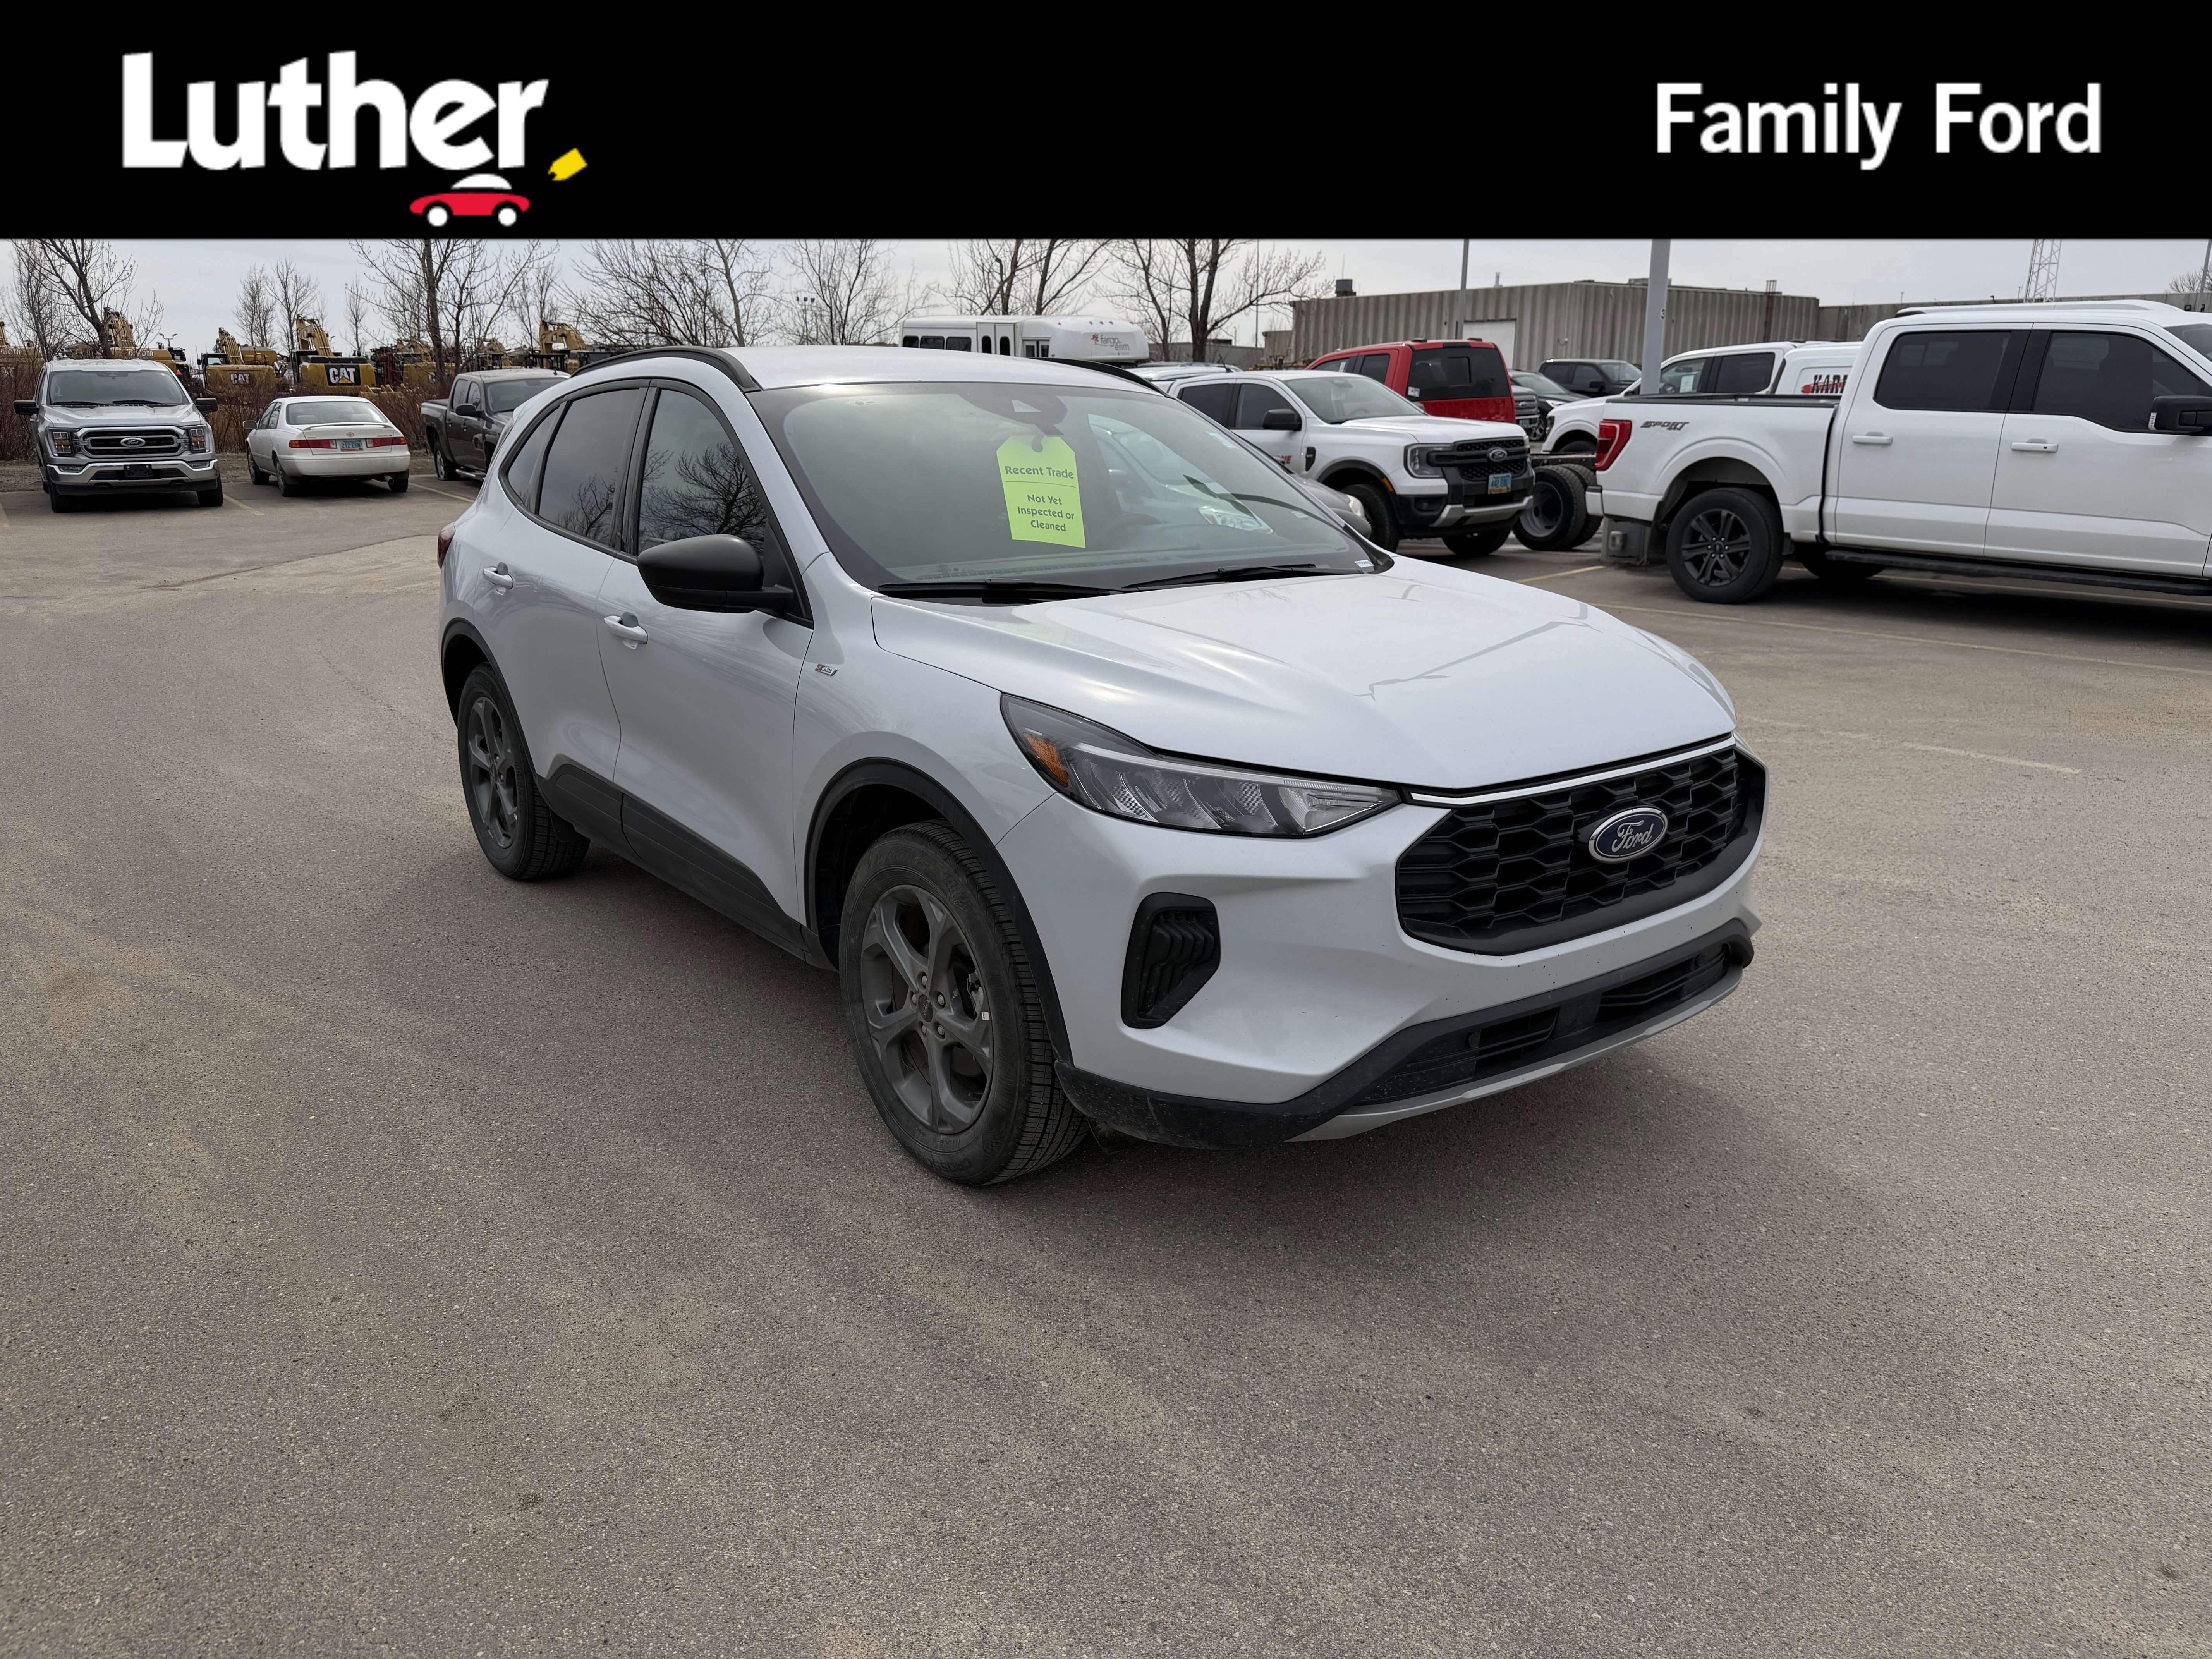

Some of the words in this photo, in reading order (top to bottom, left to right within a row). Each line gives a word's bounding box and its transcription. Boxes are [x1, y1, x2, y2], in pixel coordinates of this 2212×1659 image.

[1100, 334, 1120, 347] fargo
[230, 373, 249, 385] CAT
[329, 368, 356, 384] CAT
[1640, 421, 1690, 430] SPORT
[1005, 466, 1044, 475] Recent
[1046, 467, 1074, 479] Trade
[1027, 494, 1045, 504] Not
[1047, 496, 1062, 505] Yet
[1017, 506, 1063, 518] Inspected
[1030, 520, 1066, 532] Cleaned
[1611, 819, 1654, 852] Ford
